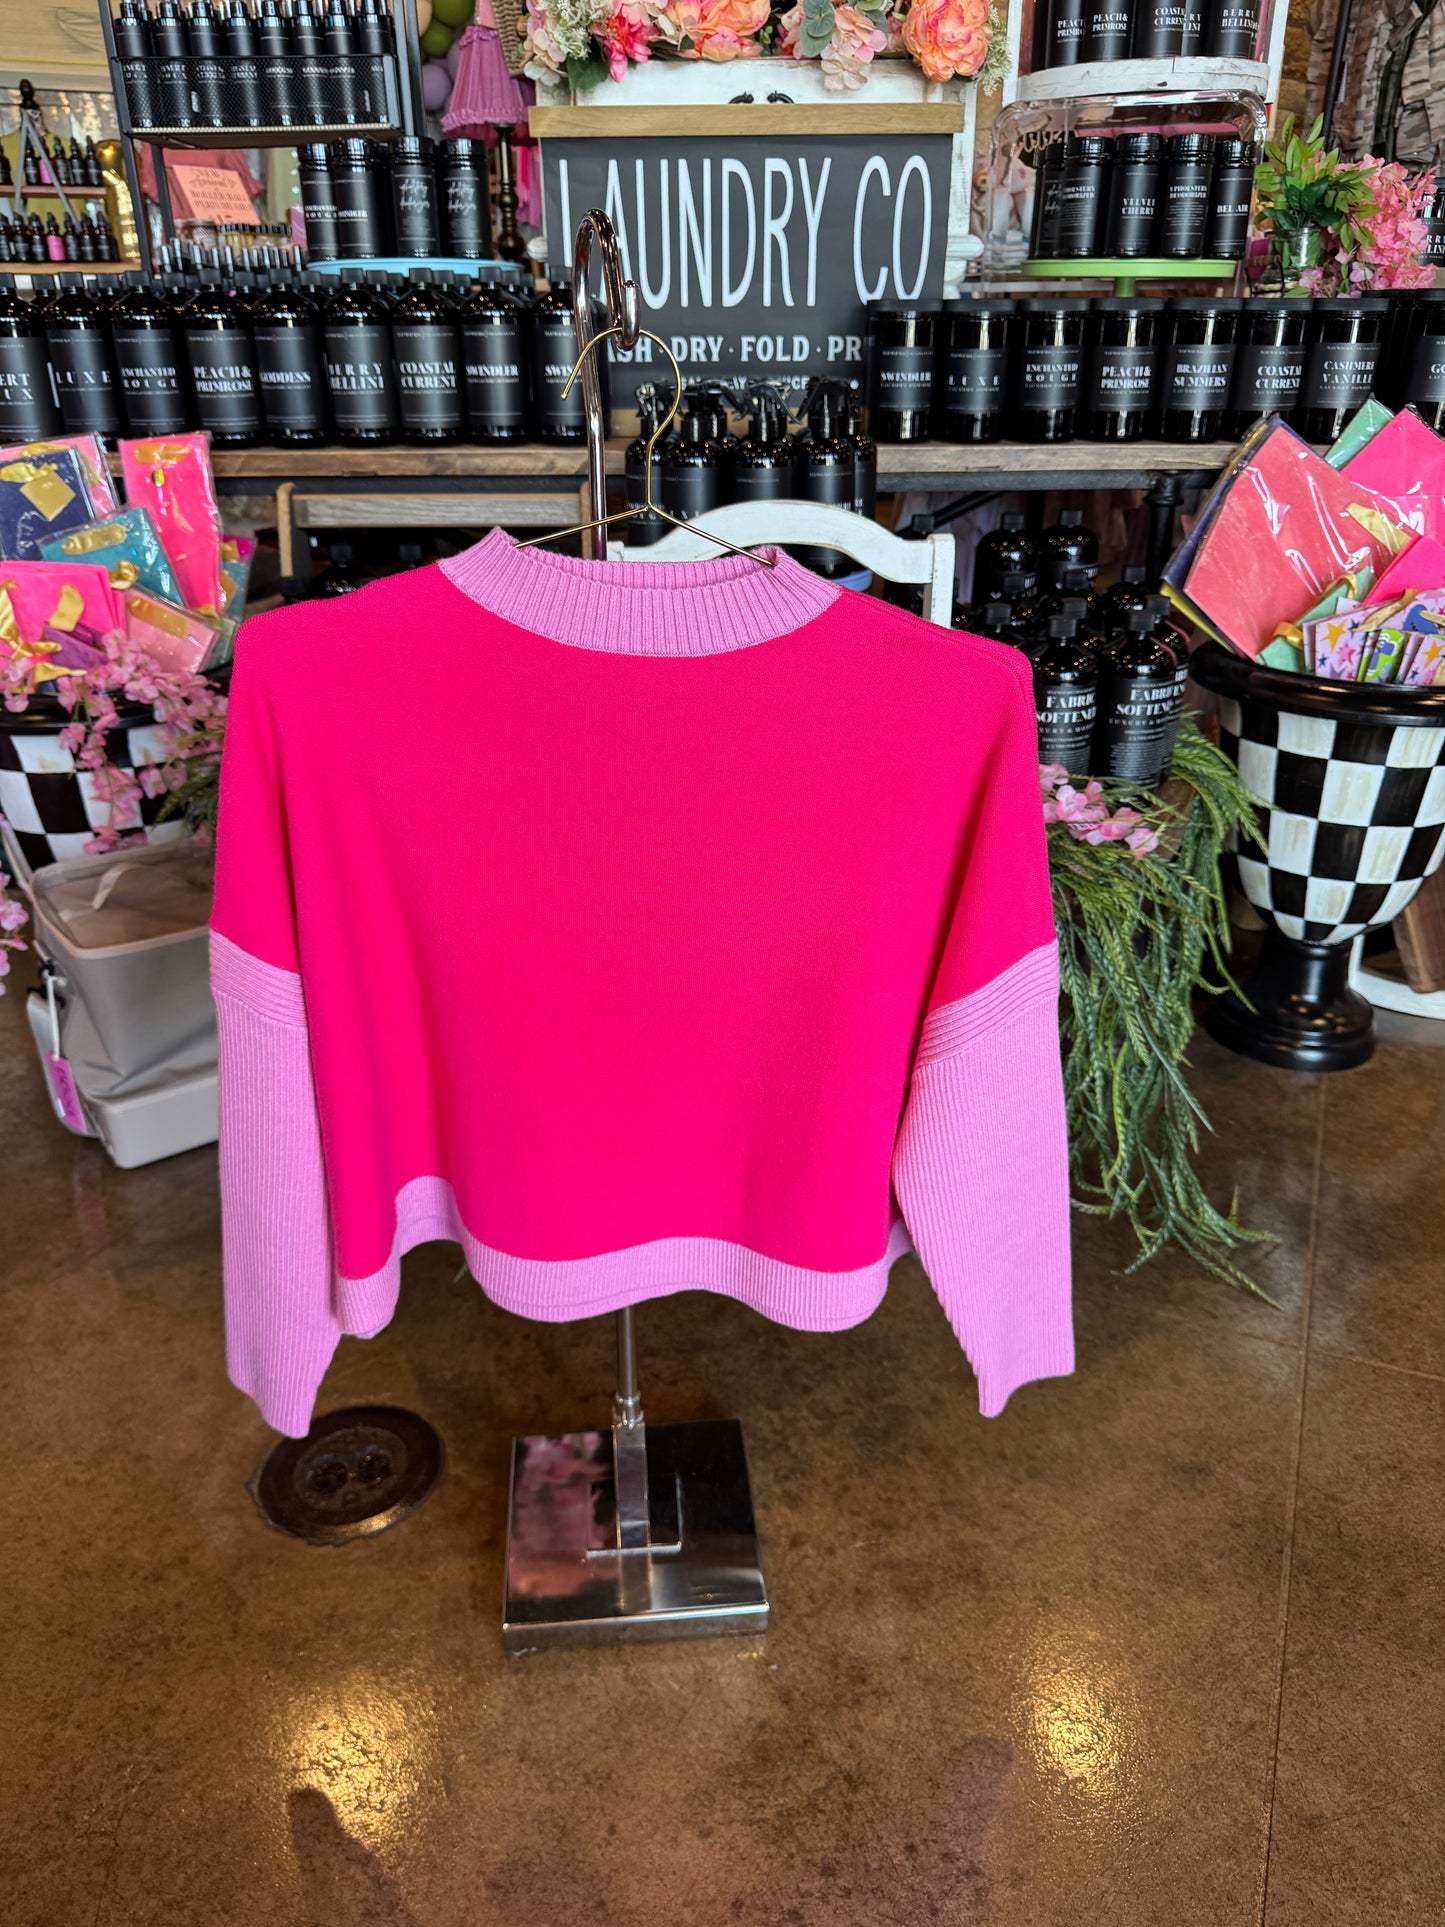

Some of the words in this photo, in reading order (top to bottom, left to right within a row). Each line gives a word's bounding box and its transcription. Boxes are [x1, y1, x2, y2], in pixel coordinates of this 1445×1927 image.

[559, 156, 832, 310] LAUNDRY
[853, 154, 932, 305] CO
[670, 335, 724, 363] DRY
[740, 335, 811, 363] FOLD
[328, 362, 383, 376] BERRY
[399, 360, 457, 375] COASTAL
[465, 364, 519, 376] SWINDLER
[1176, 363, 1228, 374] BRAZILIAN
[1323, 360, 1376, 372] CASHMERE
[56, 370, 112, 385] LUXE
[330, 375, 384, 390] BELLINI
[400, 375, 456, 389] CURRENT
[880, 371, 932, 382] SWINDLER
[1173, 376, 1227, 388] SUMMERS
[196, 379, 253, 392] PRIMROSE
[1101, 378, 1151, 389] PRIMROSE
